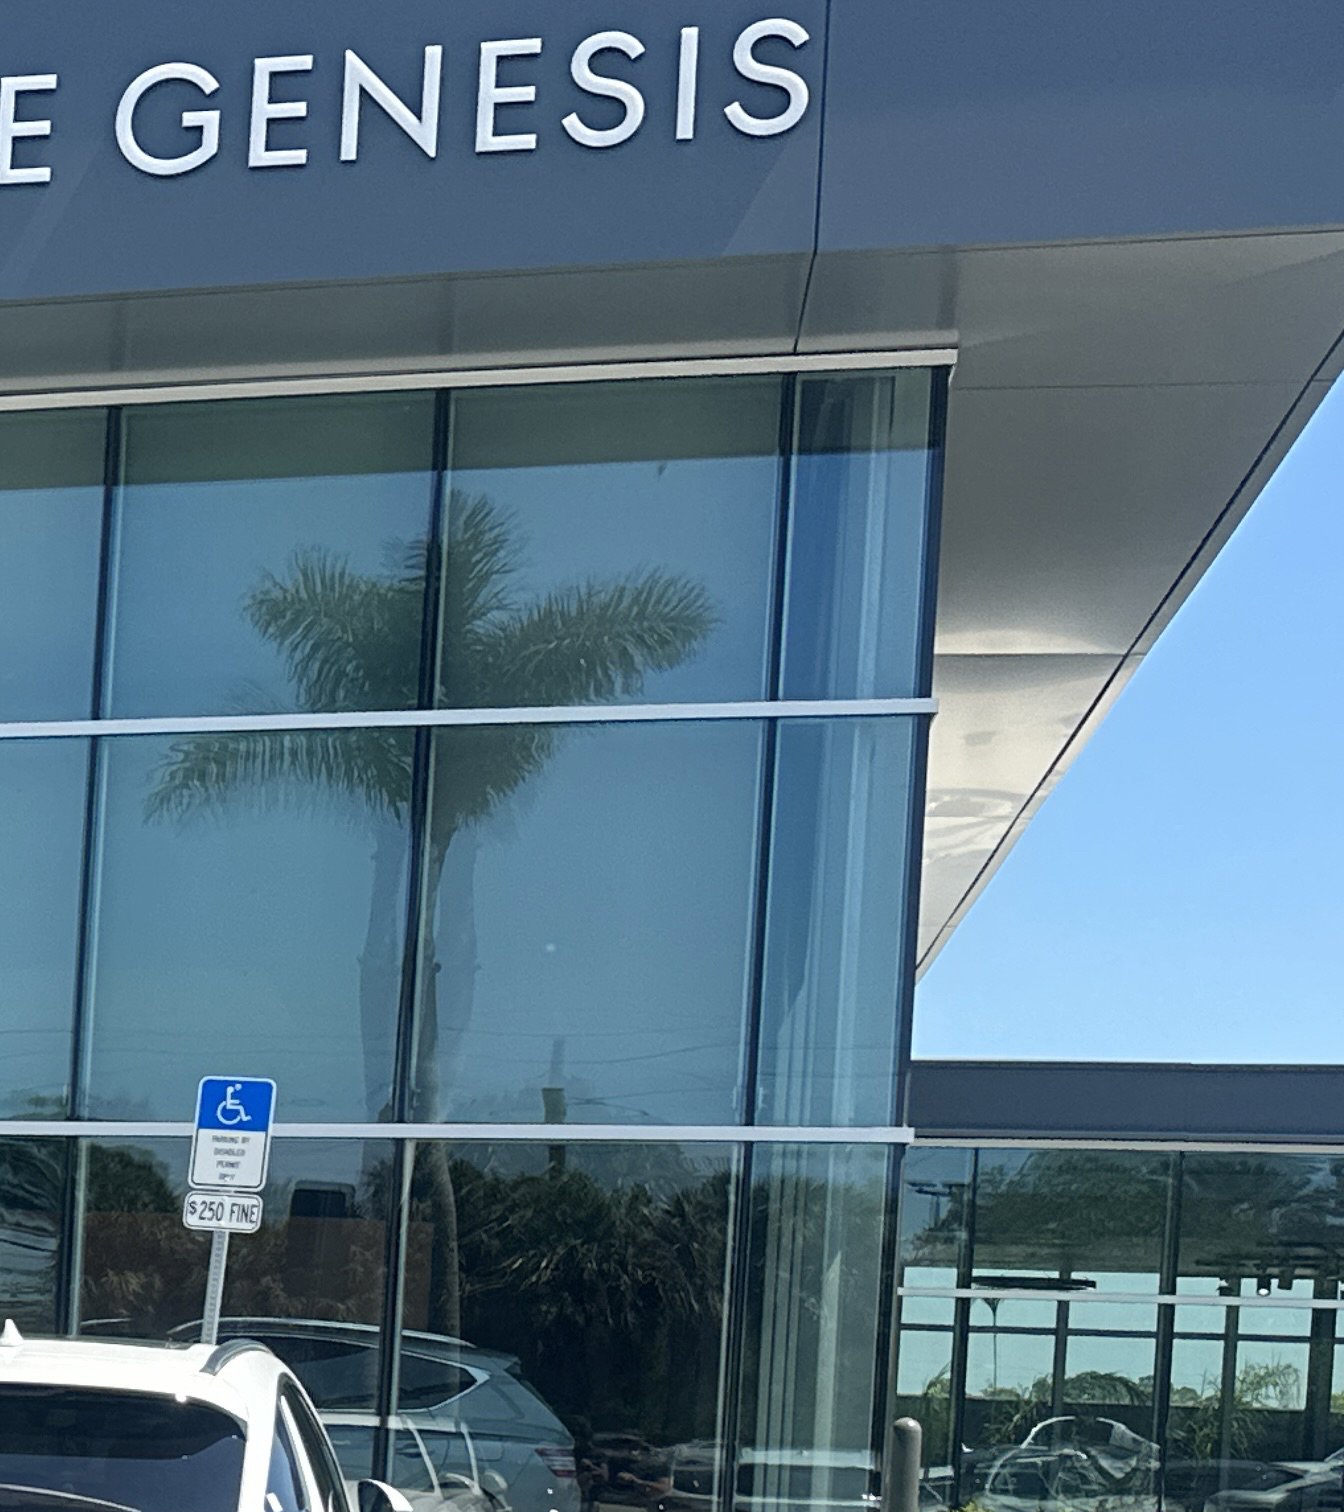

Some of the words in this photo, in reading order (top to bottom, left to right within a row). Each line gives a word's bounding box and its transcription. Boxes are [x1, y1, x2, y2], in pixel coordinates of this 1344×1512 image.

[112, 17, 811, 178] GENESIS
[189, 1200, 224, 1221] $250
[229, 1203, 260, 1224] FINE
